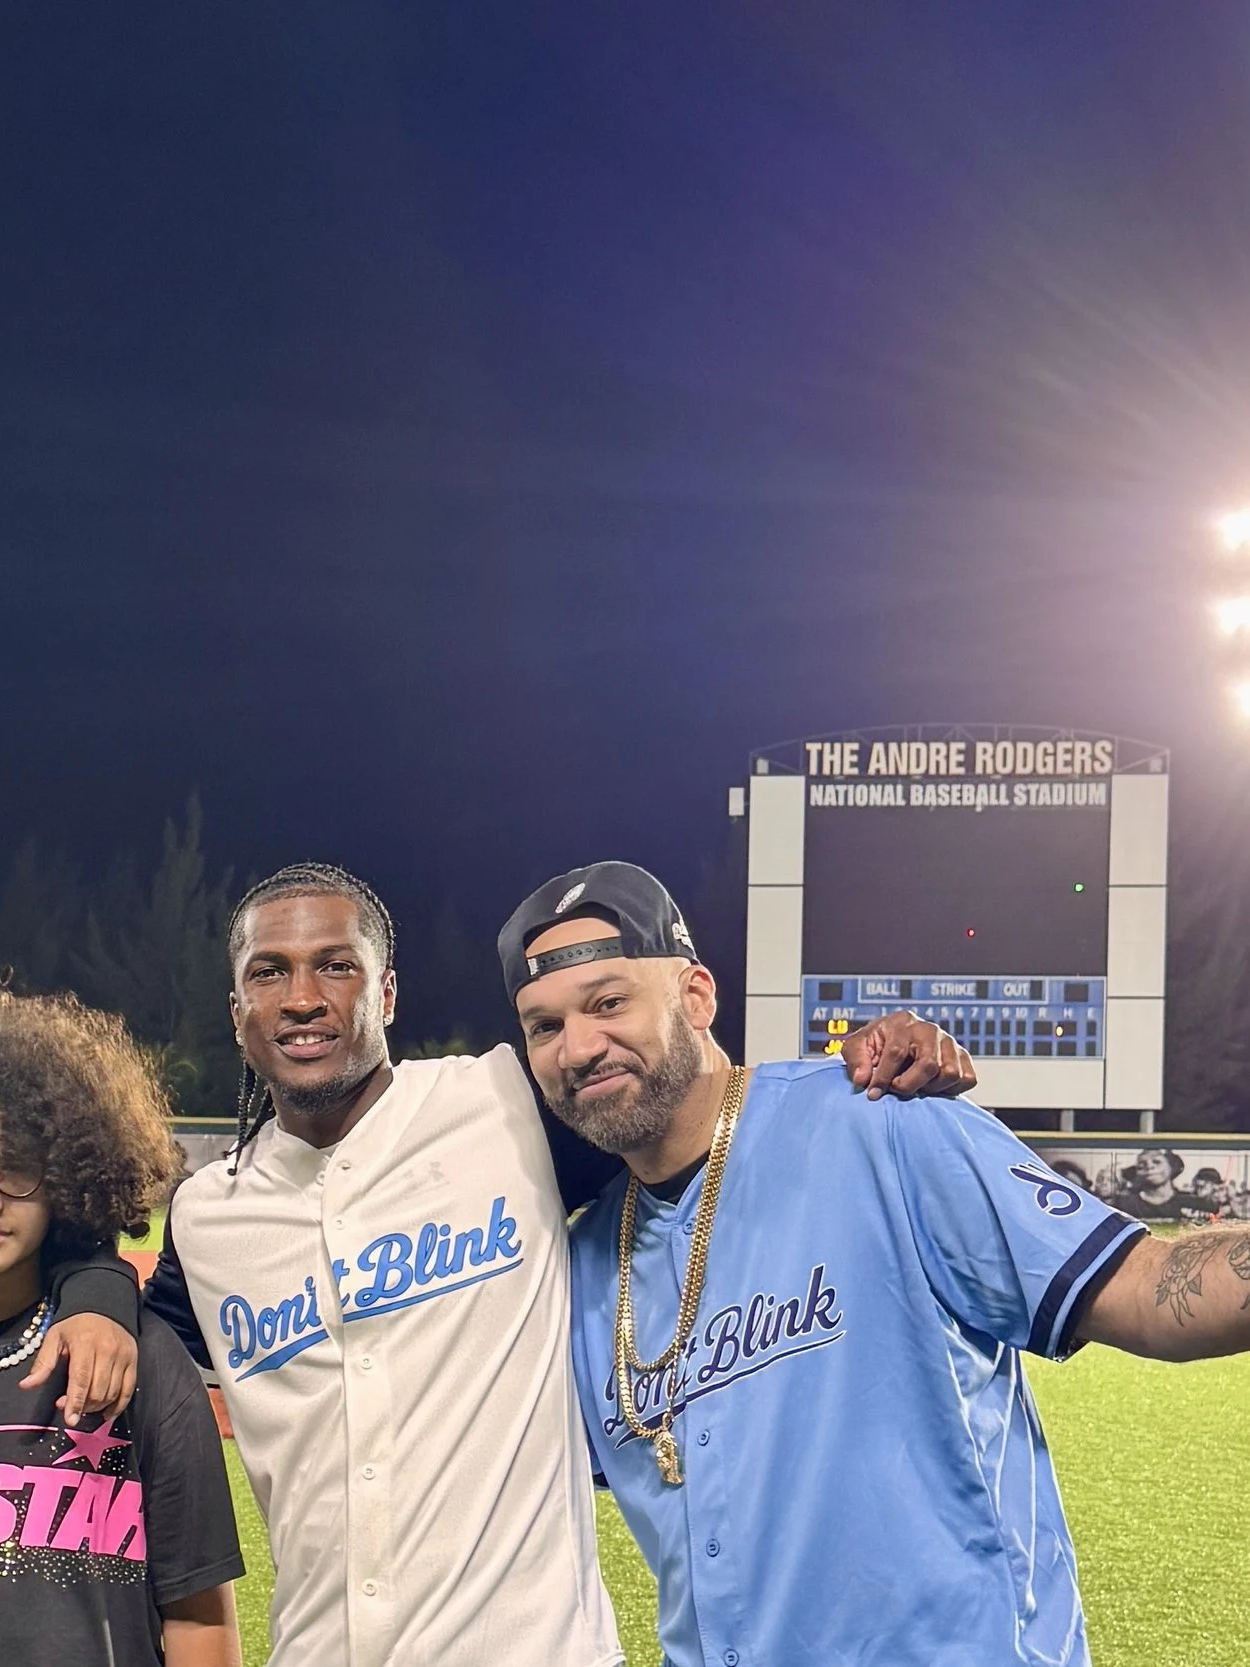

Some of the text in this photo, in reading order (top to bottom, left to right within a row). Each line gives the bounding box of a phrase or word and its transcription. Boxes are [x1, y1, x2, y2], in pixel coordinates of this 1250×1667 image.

[806, 740, 1112, 776] THE ANDRE RODGERS
[810, 782, 1107, 807] NATIONAL BASEBALL STADIUM
[866, 982, 1030, 996] BALL STRIKE OUT
[812, 1006, 828, 1020] AT
[833, 1006, 856, 1020] BAT
[941, 1006, 949, 1018] 5
[955, 1006, 964, 1018] 6
[971, 1006, 979, 1018] 7
[986, 1006, 995, 1018] 8
[1002, 1006, 1010, 1018] 9
[1015, 1006, 1028, 1018] 10
[219, 1196, 523, 1369] Don't Blink
[697, 1264, 843, 1384] Blink
